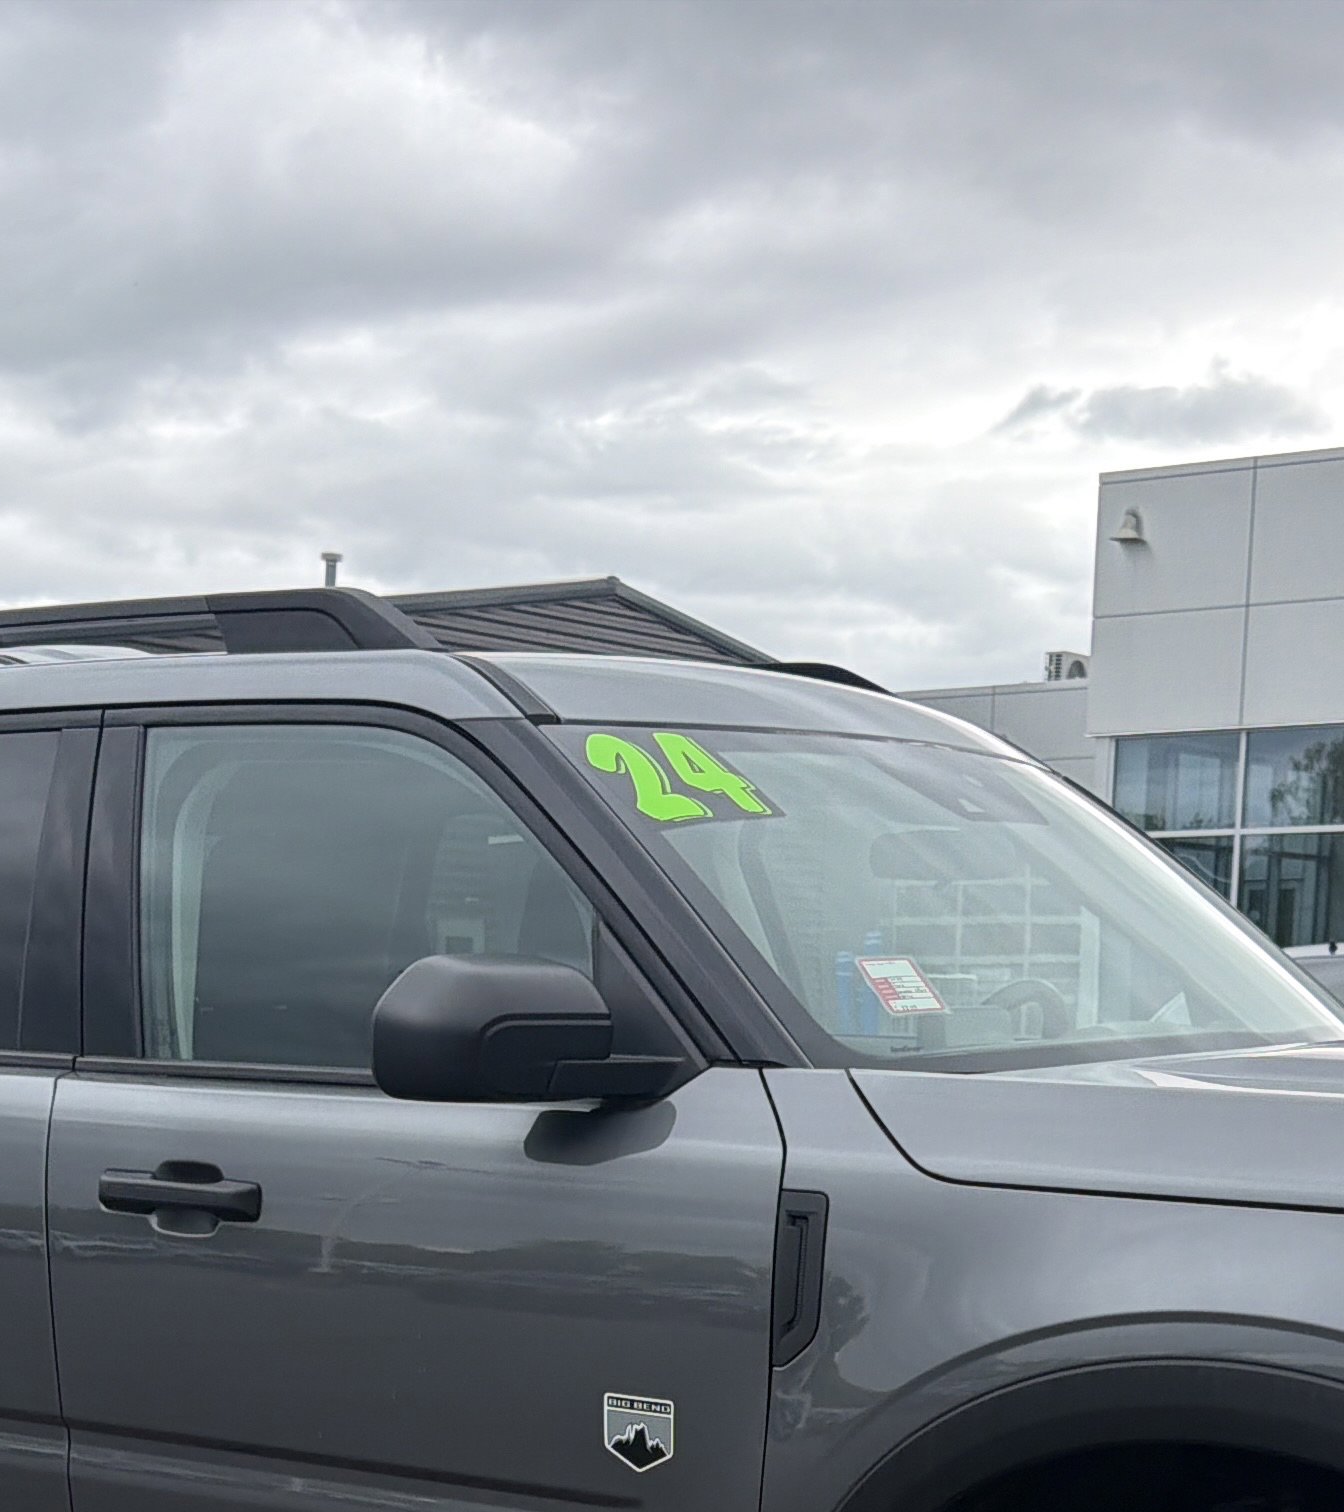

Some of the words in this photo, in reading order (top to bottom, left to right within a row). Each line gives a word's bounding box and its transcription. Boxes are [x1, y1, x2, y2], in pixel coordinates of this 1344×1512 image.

[584, 732, 773, 822] 24
[608, 1398, 631, 1408] BIG
[633, 1401, 671, 1413] BEND
